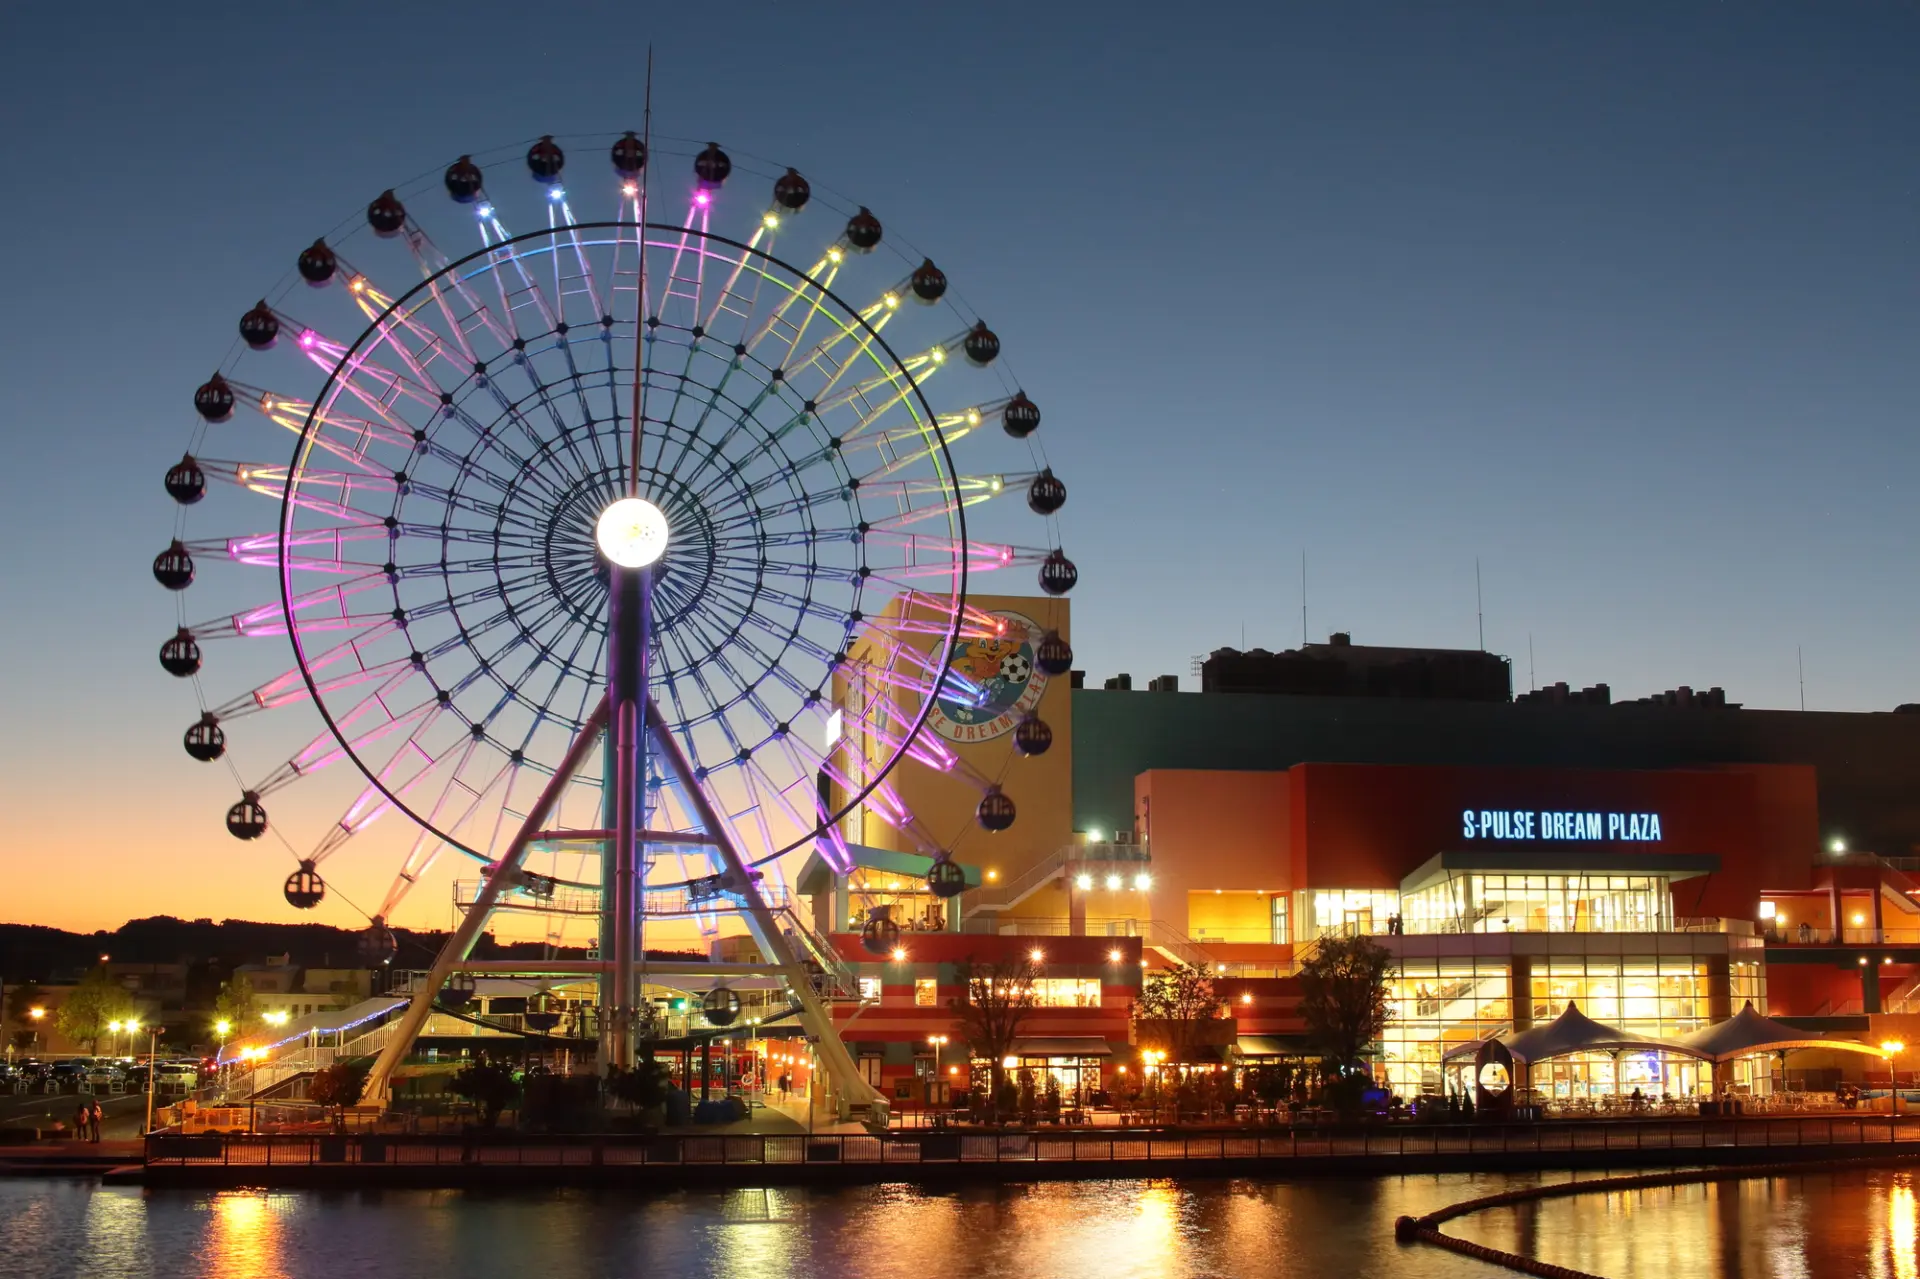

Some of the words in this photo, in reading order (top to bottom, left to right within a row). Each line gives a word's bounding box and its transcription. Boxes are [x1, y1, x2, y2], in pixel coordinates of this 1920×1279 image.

[954, 713, 1013, 740] DREAM
[1463, 810, 1535, 839] S-PULSE
[1541, 812, 1602, 840] DREAM
[1608, 813, 1661, 841] PLAZA
